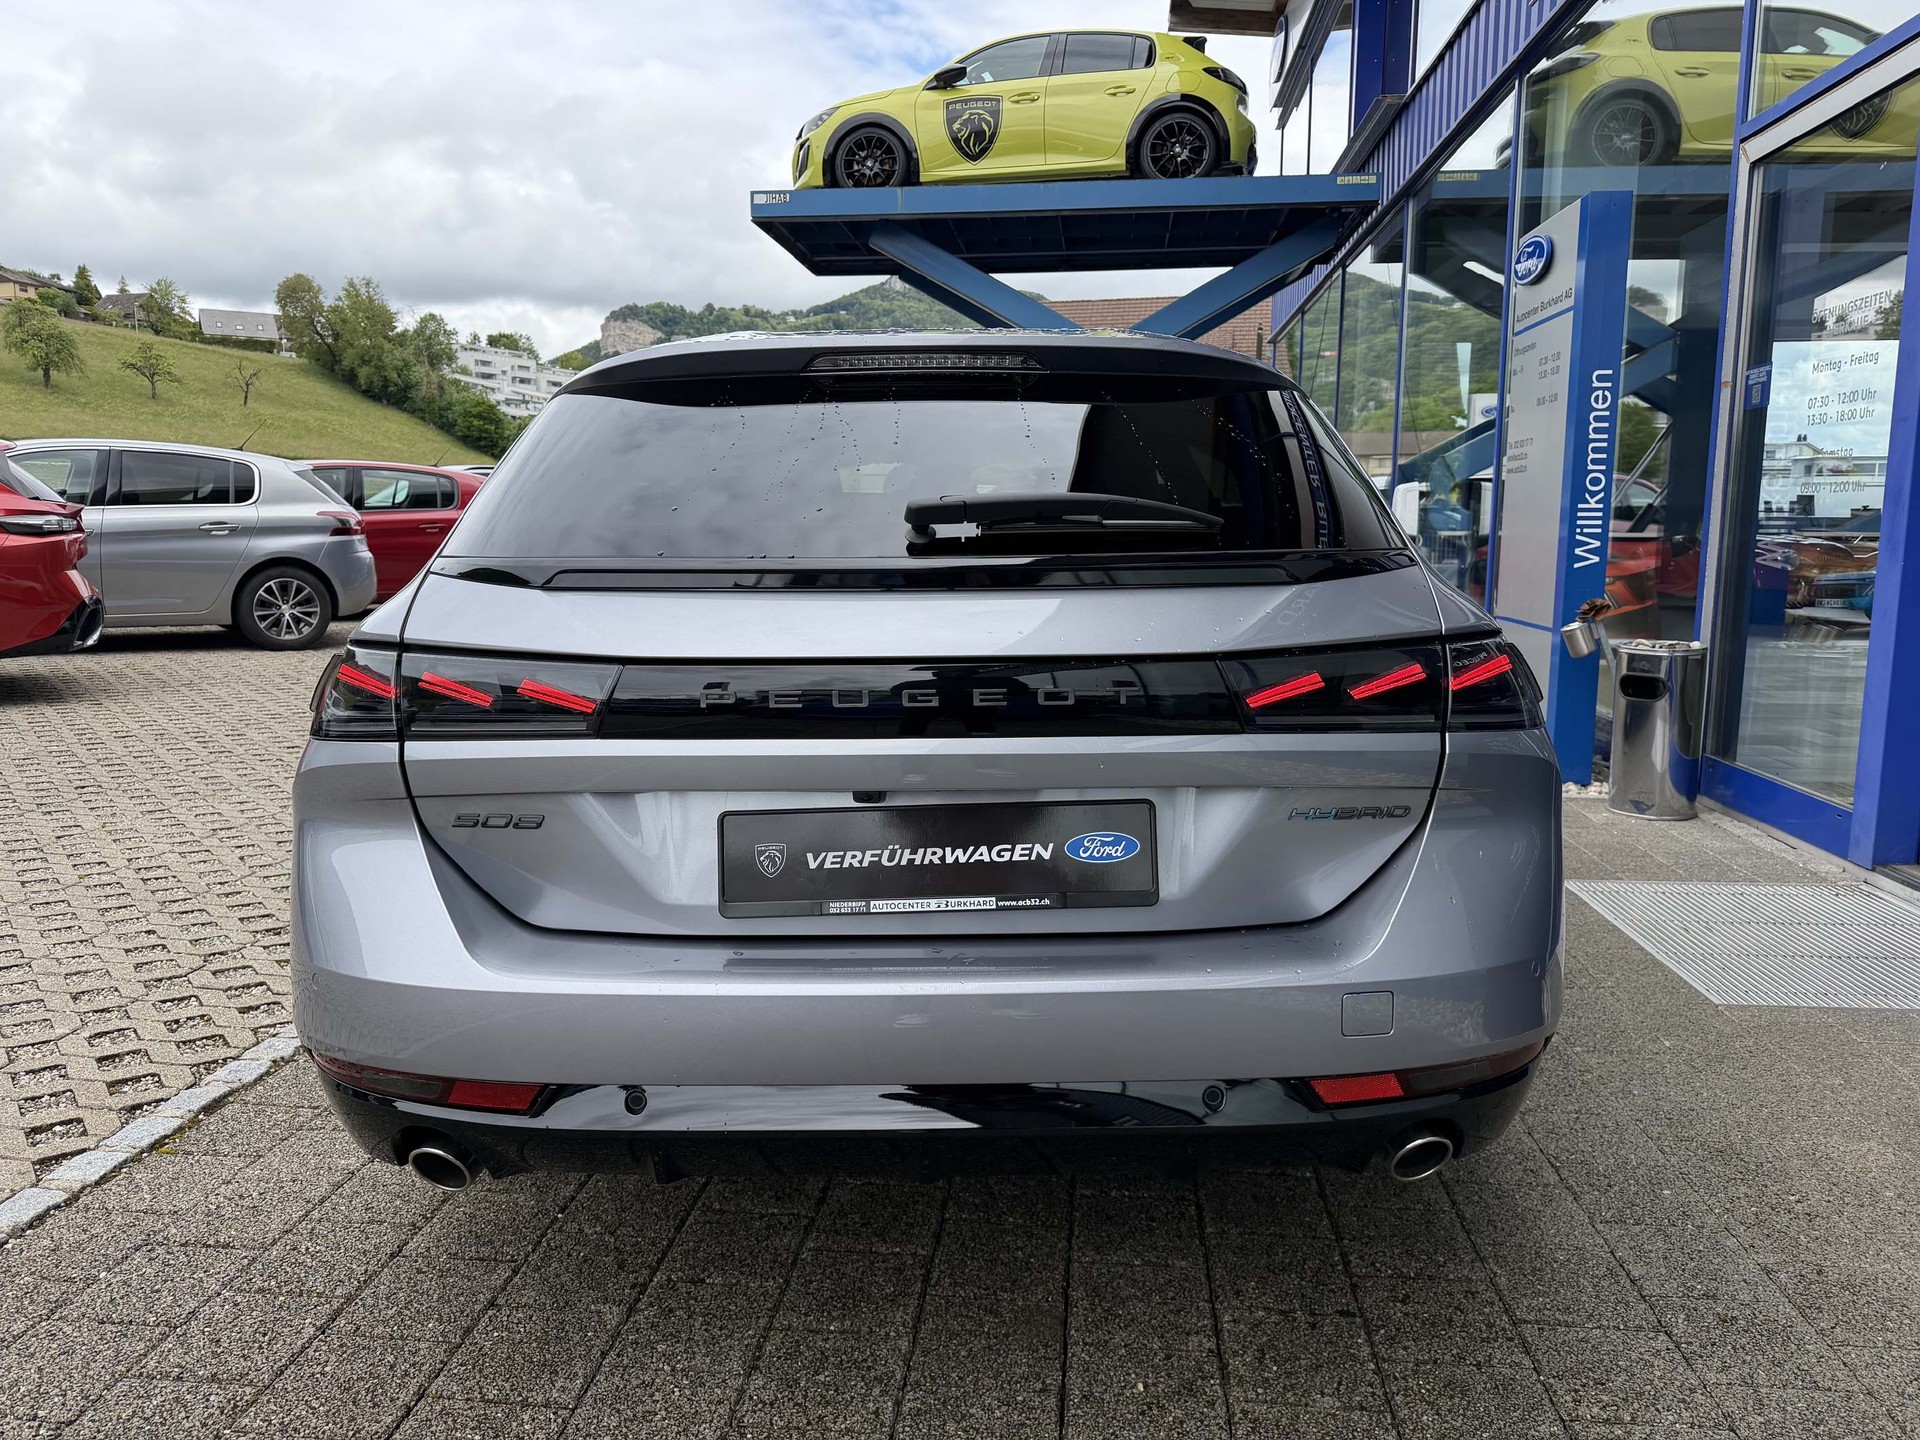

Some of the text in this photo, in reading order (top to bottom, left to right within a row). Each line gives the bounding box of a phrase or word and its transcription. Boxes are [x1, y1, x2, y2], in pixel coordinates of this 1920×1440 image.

[949, 101, 997, 110] PEUGEOT
[1540, 291, 1564, 312] Burkhard
[1564, 288, 1573, 300] AG
[1812, 289, 1892, 324] ÖFFNUNGSZEITEN
[1812, 360, 1842, 375] Montag
[1850, 352, 1880, 367] Freitag
[1808, 395, 1830, 409] 07:30
[1837, 390, 1859, 405] 12:00
[1861, 387, 1877, 401] Uhr
[1807, 413, 1828, 426] 13:30
[1836, 408, 1858, 422] 18:00
[1860, 406, 1875, 419] Uhr
[1573, 369, 1613, 568] Willkommen
[1801, 482, 1820, 493] 09:00
[1829, 481, 1850, 493] 12:00
[1852, 480, 1866, 492] Uhr
[701, 687, 1141, 708] PEUGEOT
[452, 813, 545, 829] 508
[1288, 806, 1411, 820] HYBRID
[806, 843, 1054, 869] VERFÜHRWAGEN
[872, 902, 931, 911] AUTOCENTER
[997, 898, 1050, 907] www.acb32.ch
